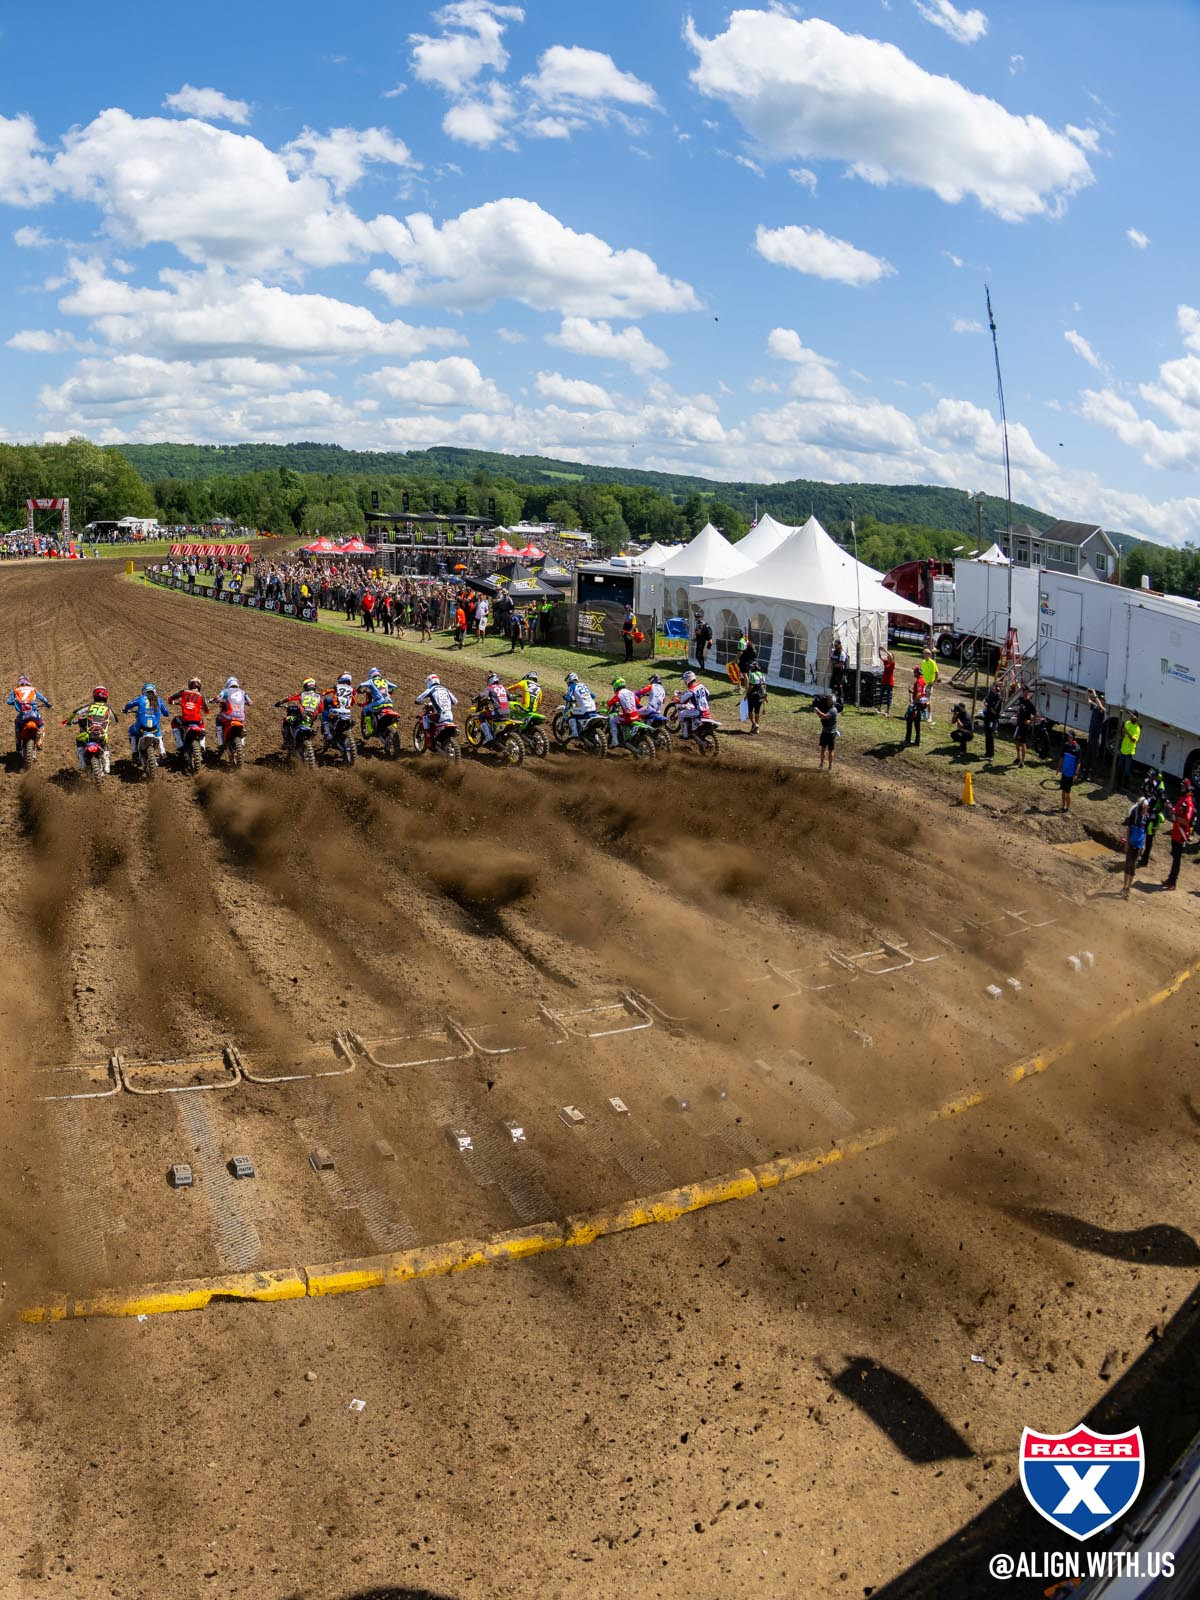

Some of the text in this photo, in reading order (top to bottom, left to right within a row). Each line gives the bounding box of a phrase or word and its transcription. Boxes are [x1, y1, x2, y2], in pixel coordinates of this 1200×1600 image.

[302, 608, 311, 618] elf
[373, 679, 387, 688] 96
[21, 689, 31, 700] 7
[336, 688, 351, 699] 32
[494, 687, 506, 697] 94
[302, 696, 318, 708] 23
[88, 705, 108, 716] 58
